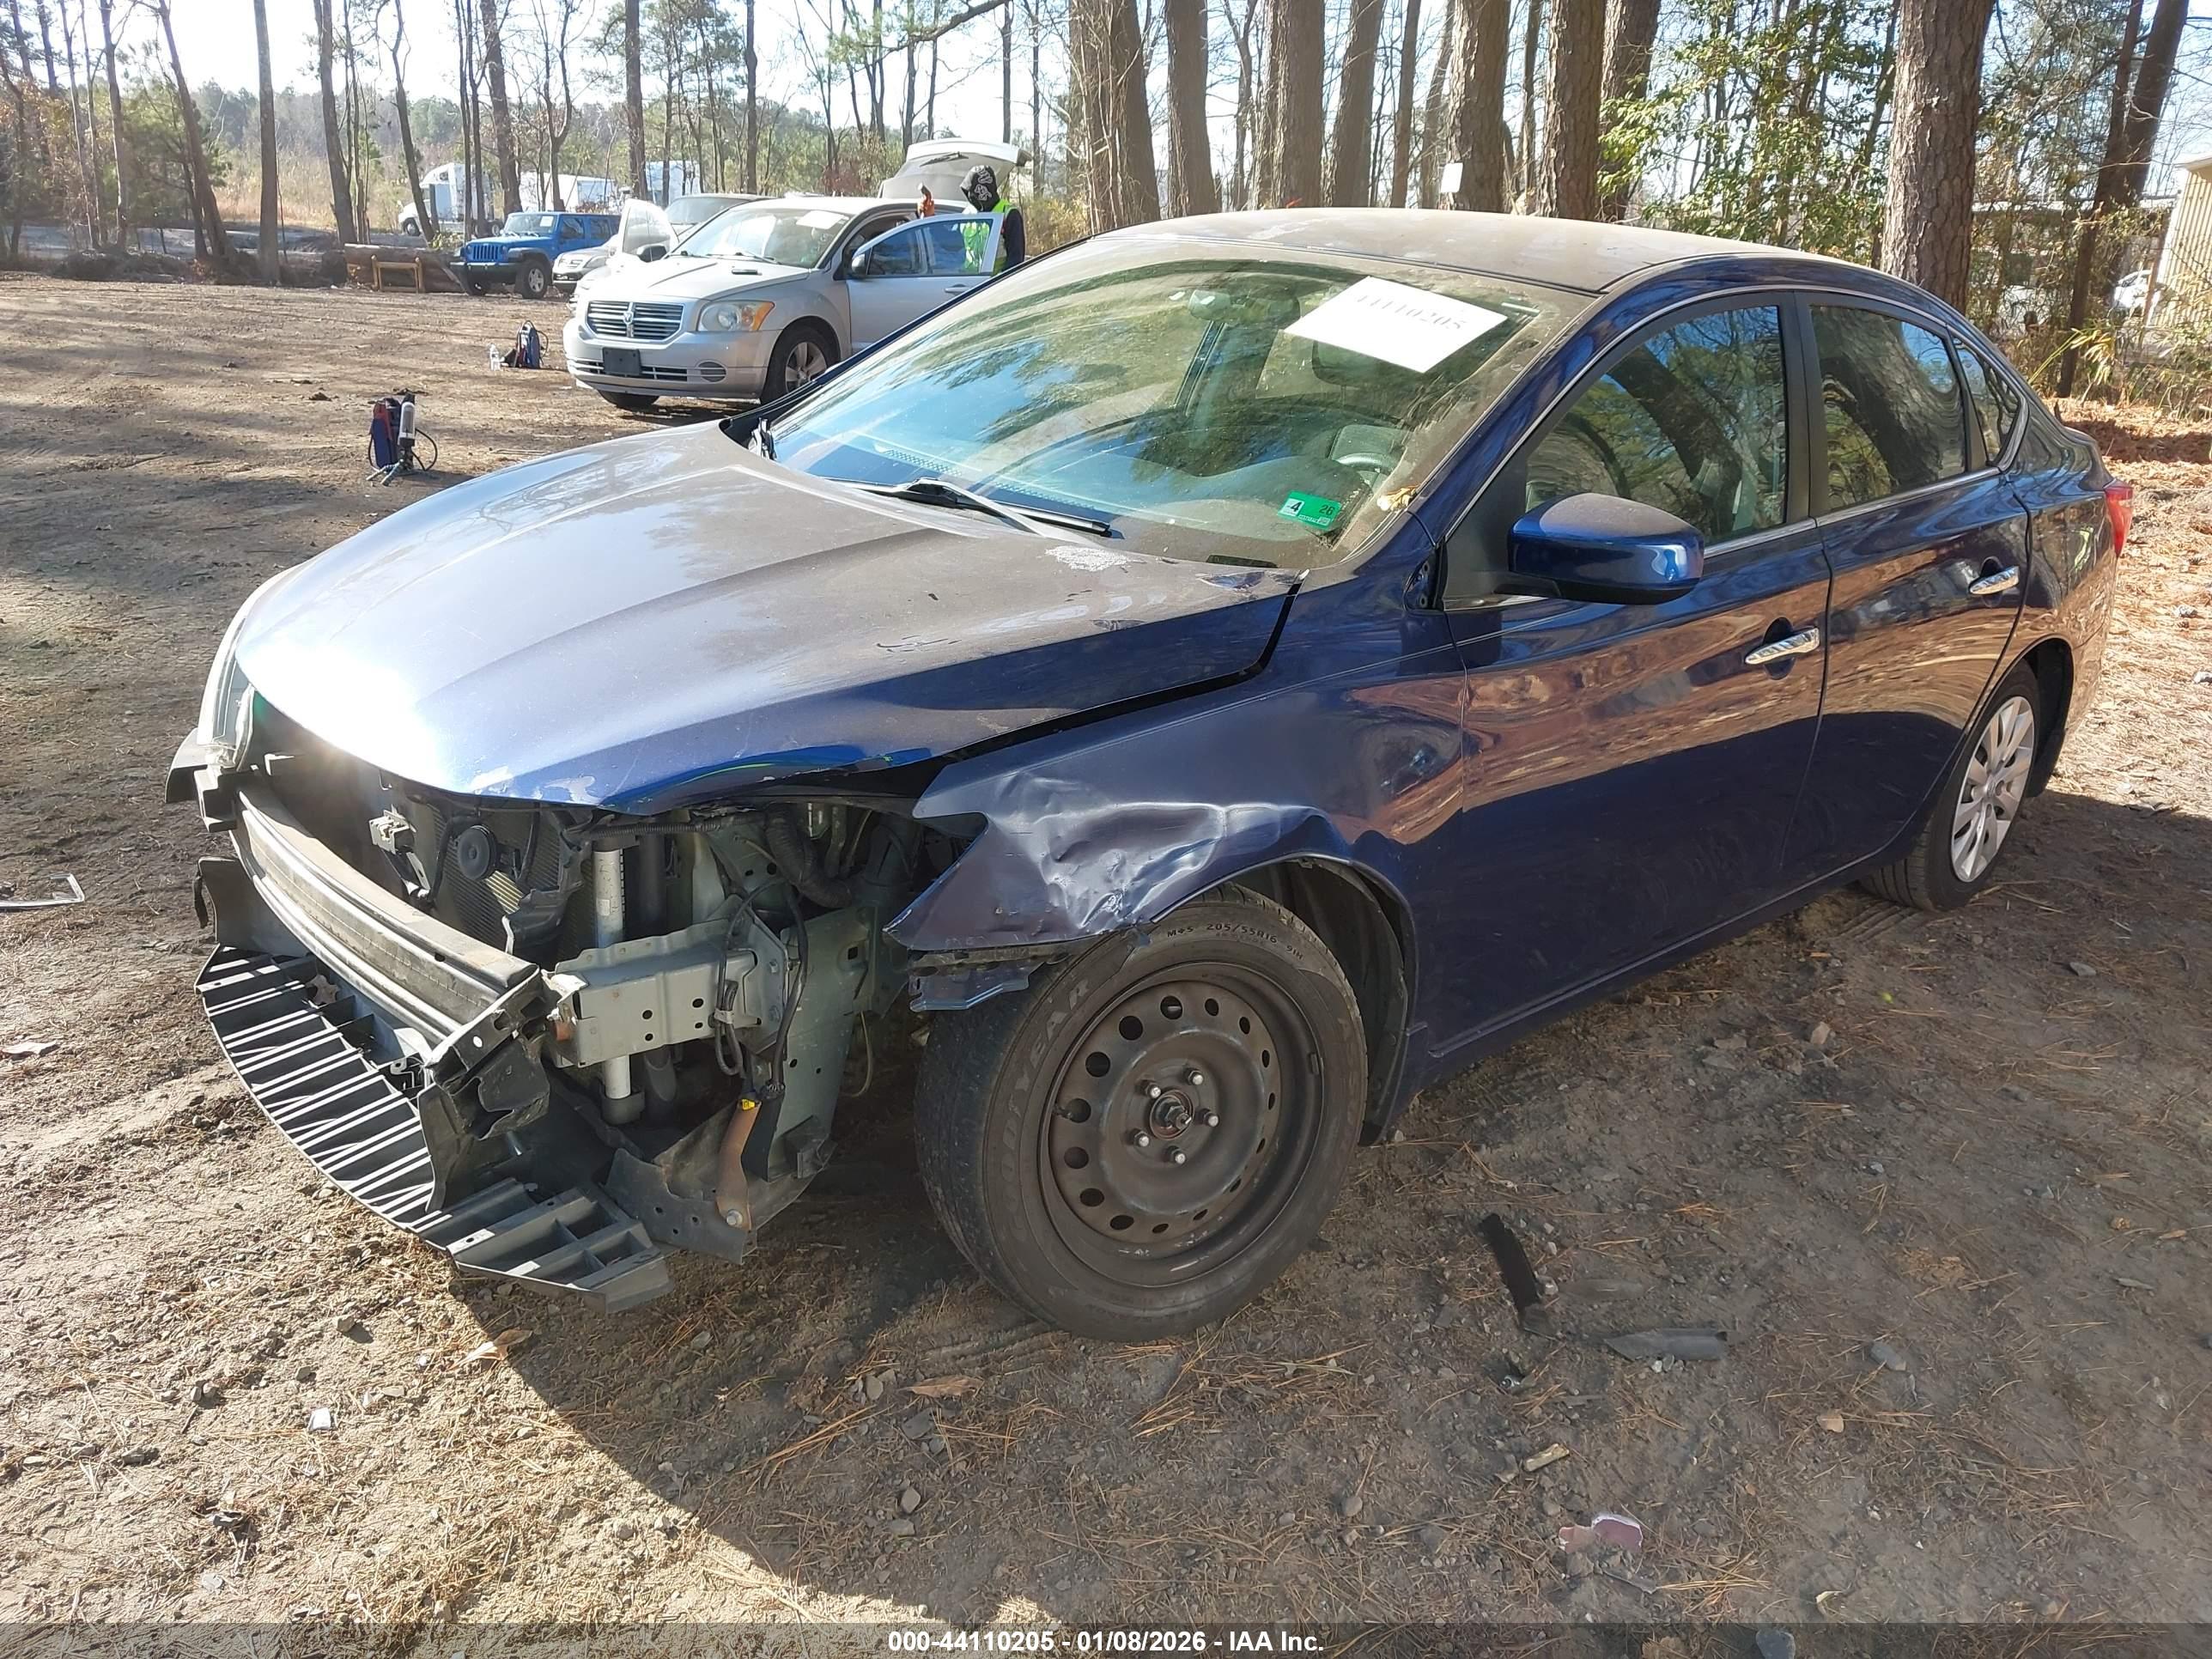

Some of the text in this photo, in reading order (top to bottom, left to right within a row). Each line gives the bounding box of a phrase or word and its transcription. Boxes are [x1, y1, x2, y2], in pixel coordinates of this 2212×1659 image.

[1290, 501, 1303, 513] 4
[1319, 504, 1335, 516] 26
[1206, 922, 1278, 945] 205/55R16
